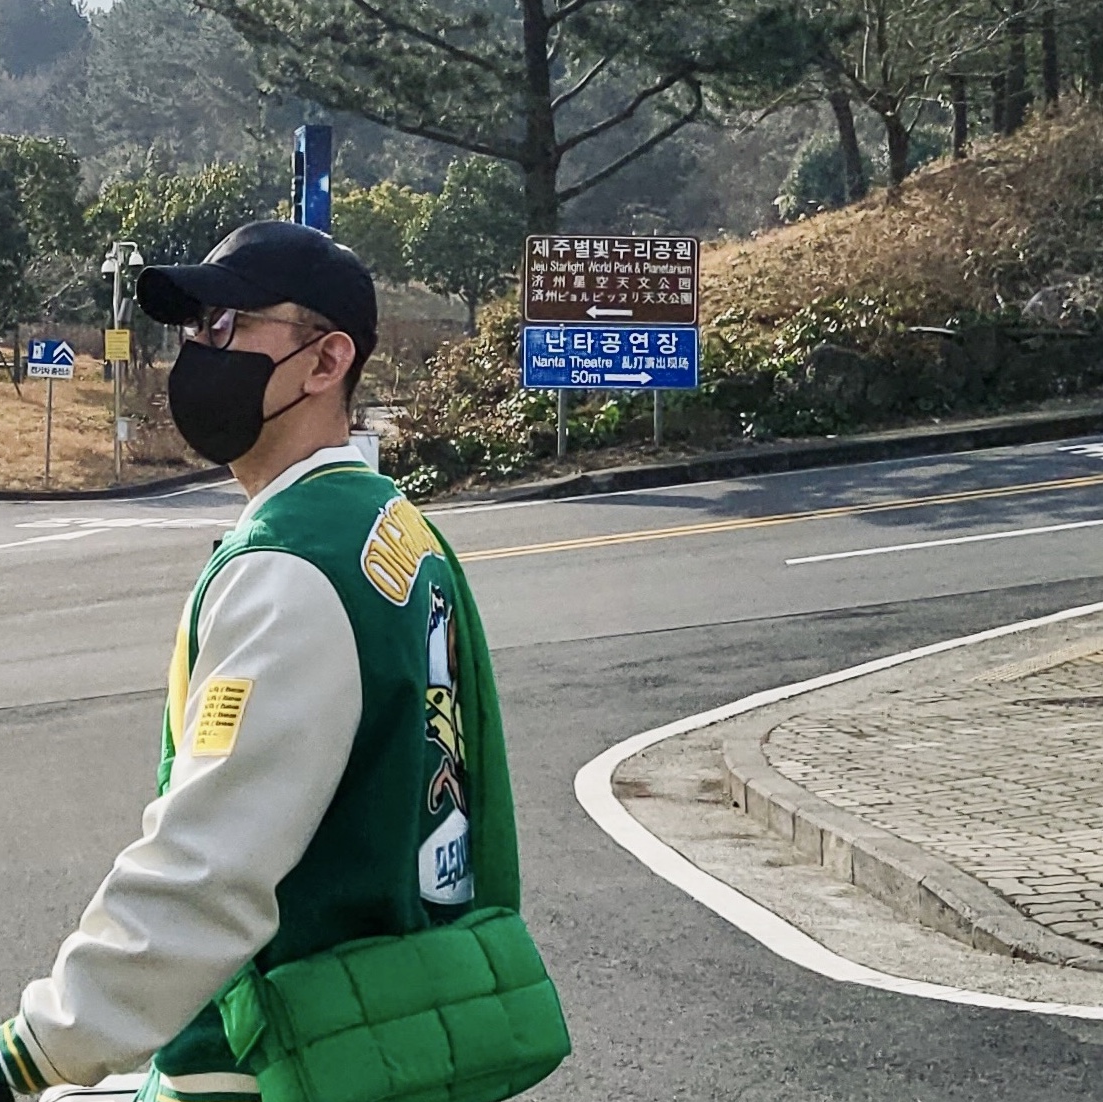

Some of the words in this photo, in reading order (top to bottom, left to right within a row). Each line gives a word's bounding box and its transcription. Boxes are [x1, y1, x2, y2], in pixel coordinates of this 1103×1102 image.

[531, 239, 691, 260] 제주별빛누리공원
[531, 260, 548, 272] Jeju
[550, 260, 585, 275] Starlight
[588, 261, 612, 273] World
[614, 262, 633, 274] Park
[635, 262, 641, 274] &
[643, 262, 692, 275] Planetarium
[545, 331, 679, 354] 난타공연장
[532, 356, 566, 369] Nanta
[569, 356, 613, 369] Theatre
[571, 370, 601, 384] 50m
